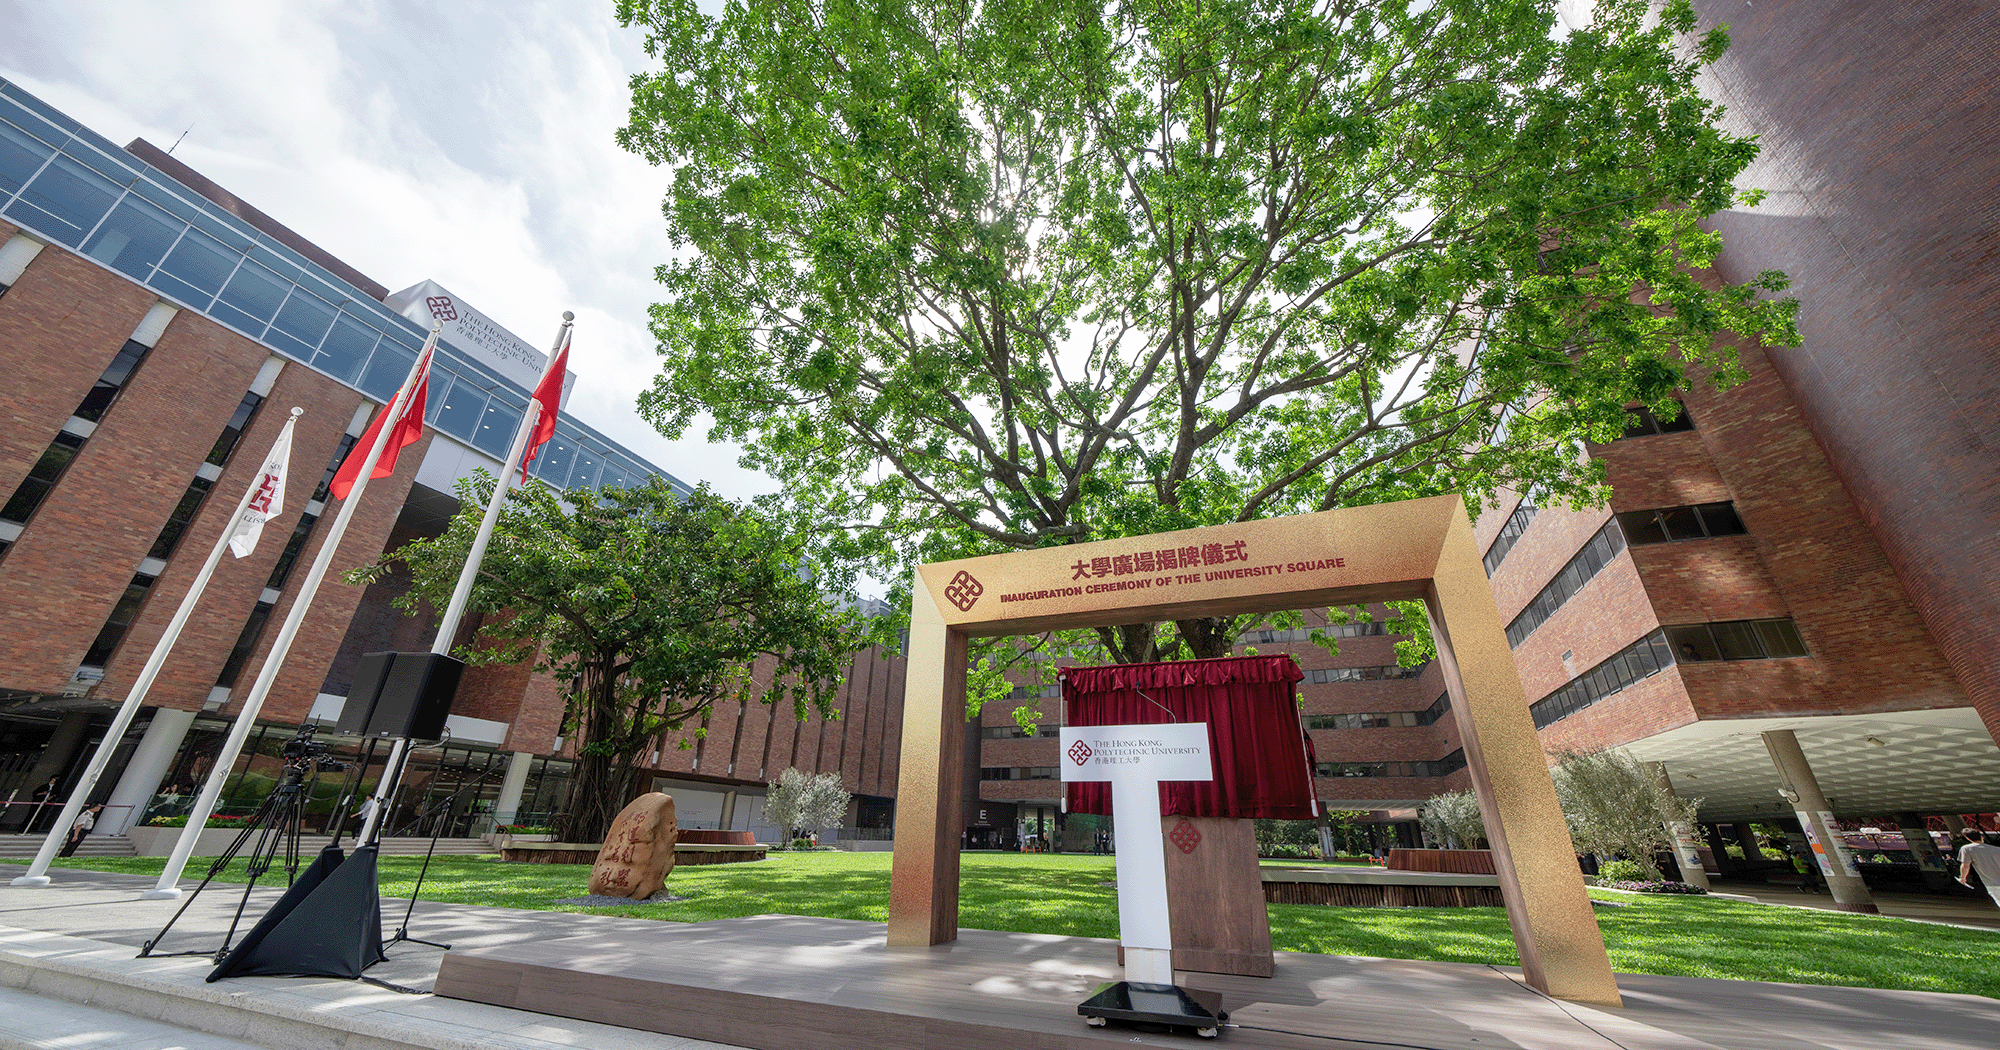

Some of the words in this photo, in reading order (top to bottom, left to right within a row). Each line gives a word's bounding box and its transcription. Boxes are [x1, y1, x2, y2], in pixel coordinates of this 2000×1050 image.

[459, 318, 521, 361] POLYTECHNIC
[463, 310, 484, 326] THE
[484, 324, 511, 346] HONG
[512, 342, 537, 362] KONG
[1071, 540, 1249, 581] 大學廣場揭牌儀式
[1000, 586, 1083, 603] INAUGURATION
[1085, 578, 1152, 595] CEREMONY
[1155, 576, 1173, 587] OF
[1175, 573, 1201, 585] THE
[1205, 564, 1284, 582] UNIVERSITY
[1287, 557, 1346, 574] SQUARE
[1093, 740, 1110, 748] THE
[1112, 739, 1137, 748] HONG
[1138, 739, 1162, 747] KONG
[1094, 748, 1150, 756] POLYTECHNIC
[1151, 747, 1201, 755] UNIVERSITY
[1094, 756, 1141, 765] 香港理工大學
[980, 810, 987, 819] E
